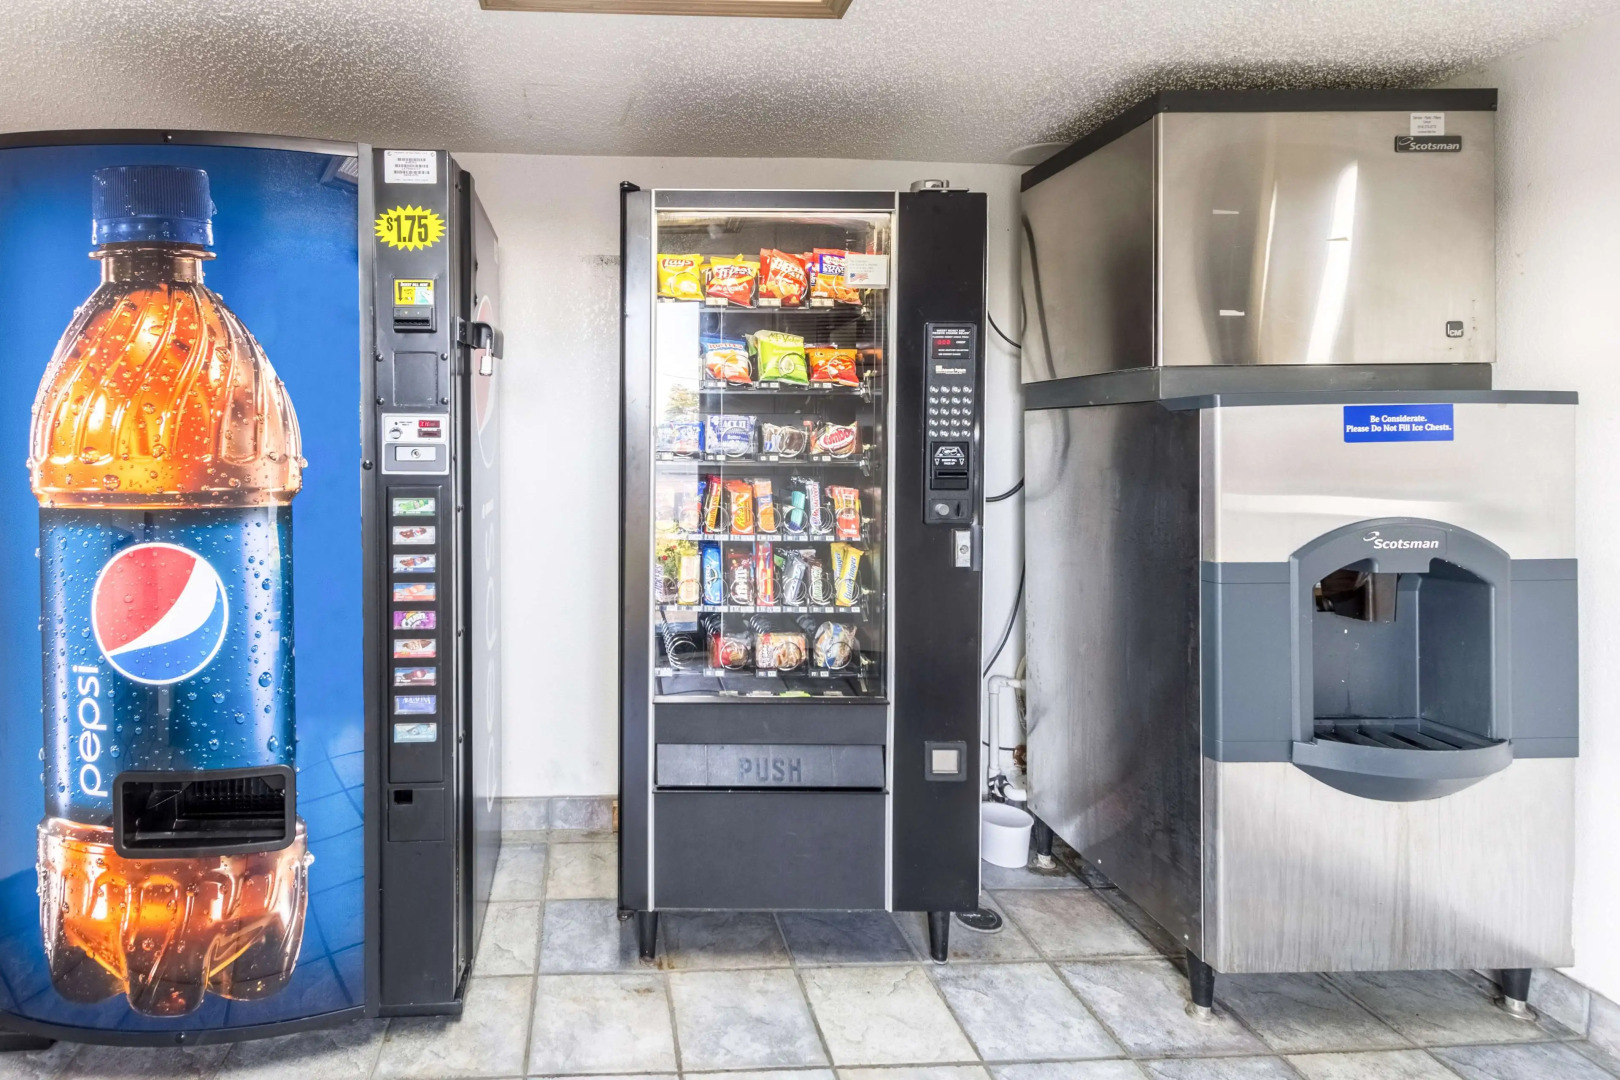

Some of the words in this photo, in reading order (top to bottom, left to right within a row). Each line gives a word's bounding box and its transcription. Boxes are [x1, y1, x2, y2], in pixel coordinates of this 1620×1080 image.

[1409, 142, 1460, 150] Scotsman
[386, 214, 429, 243] $1.75
[1370, 415, 1380, 423] Be
[1381, 414, 1428, 423] Considerate.
[1346, 424, 1369, 433] Please
[1371, 424, 1382, 432] Do
[1383, 424, 1397, 432] Not
[1399, 424, 1411, 432] Fill
[1412, 423, 1423, 431] Ice
[1424, 423, 1452, 431] Chests.
[823, 428, 855, 445] Combos
[1373, 539, 1439, 549] Scotsman
[72, 665, 108, 797] pepsi
[739, 757, 802, 783] PUSH
